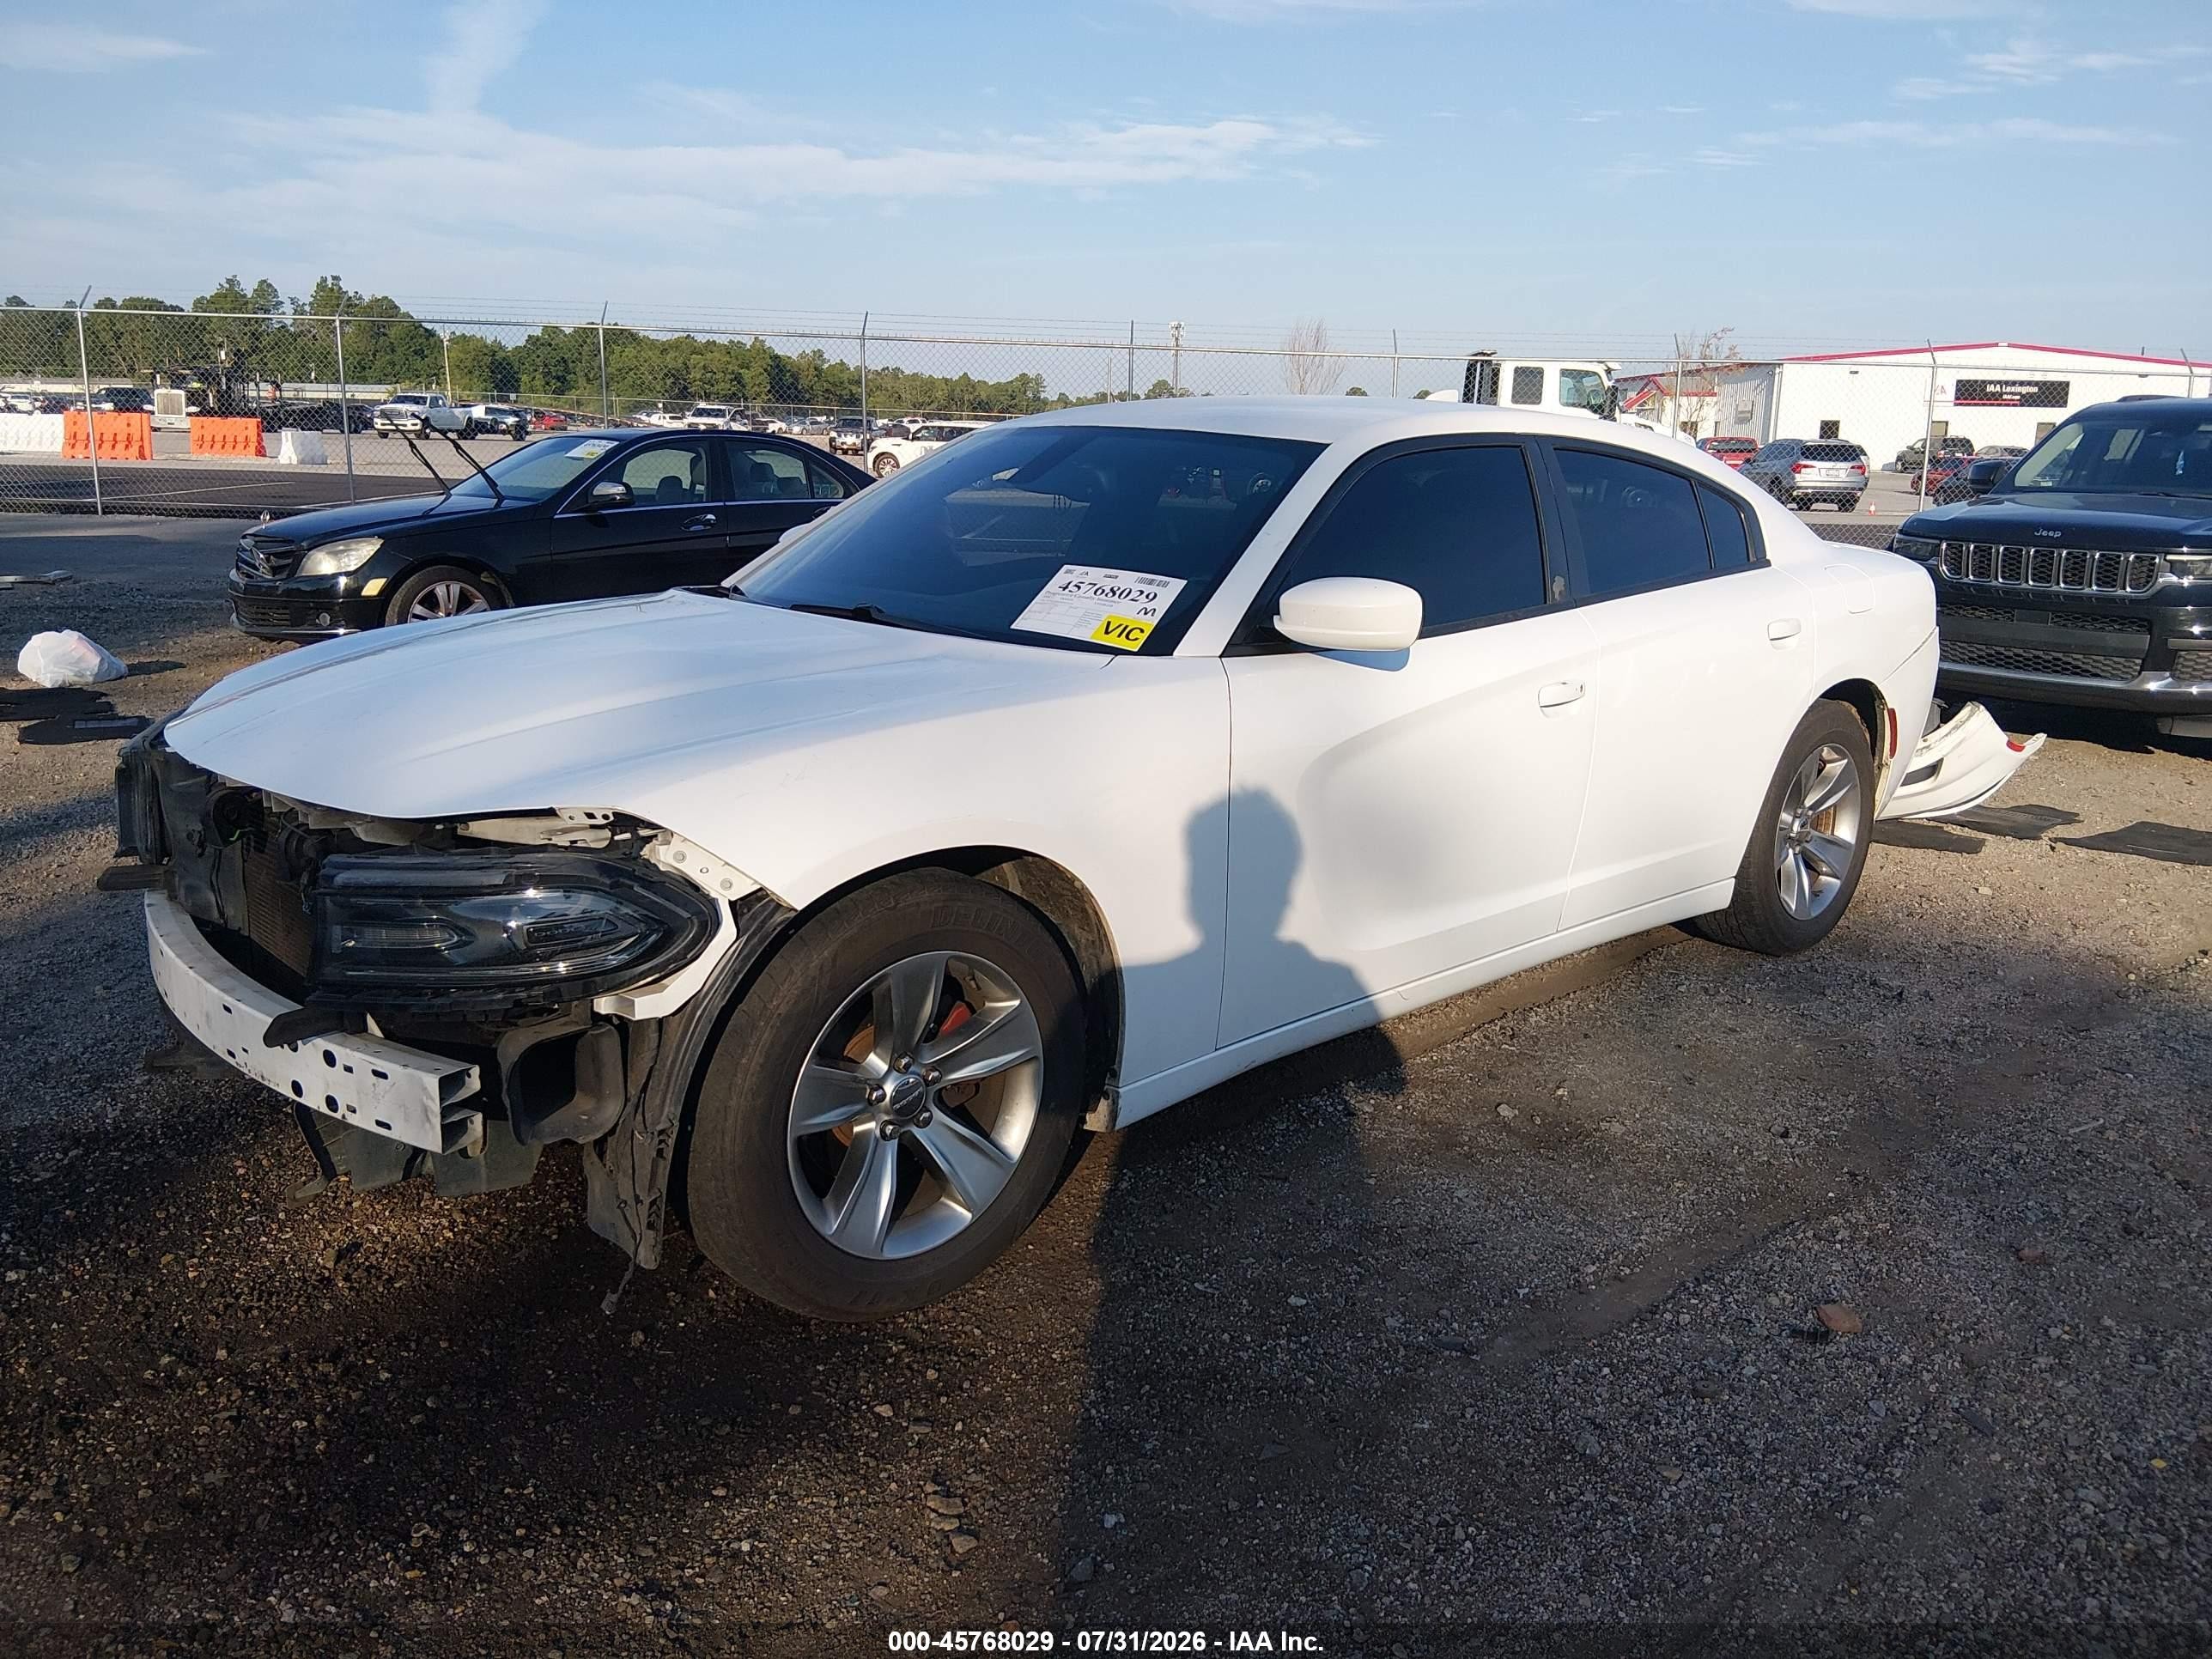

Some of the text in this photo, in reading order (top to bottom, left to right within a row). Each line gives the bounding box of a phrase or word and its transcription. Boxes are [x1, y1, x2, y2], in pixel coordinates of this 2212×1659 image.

[1986, 384, 2039, 394] IAA Lexington
[2034, 528, 2062, 538] Jeep
[1058, 580, 1158, 604] 45768029
[1103, 620, 1145, 642] VIC
